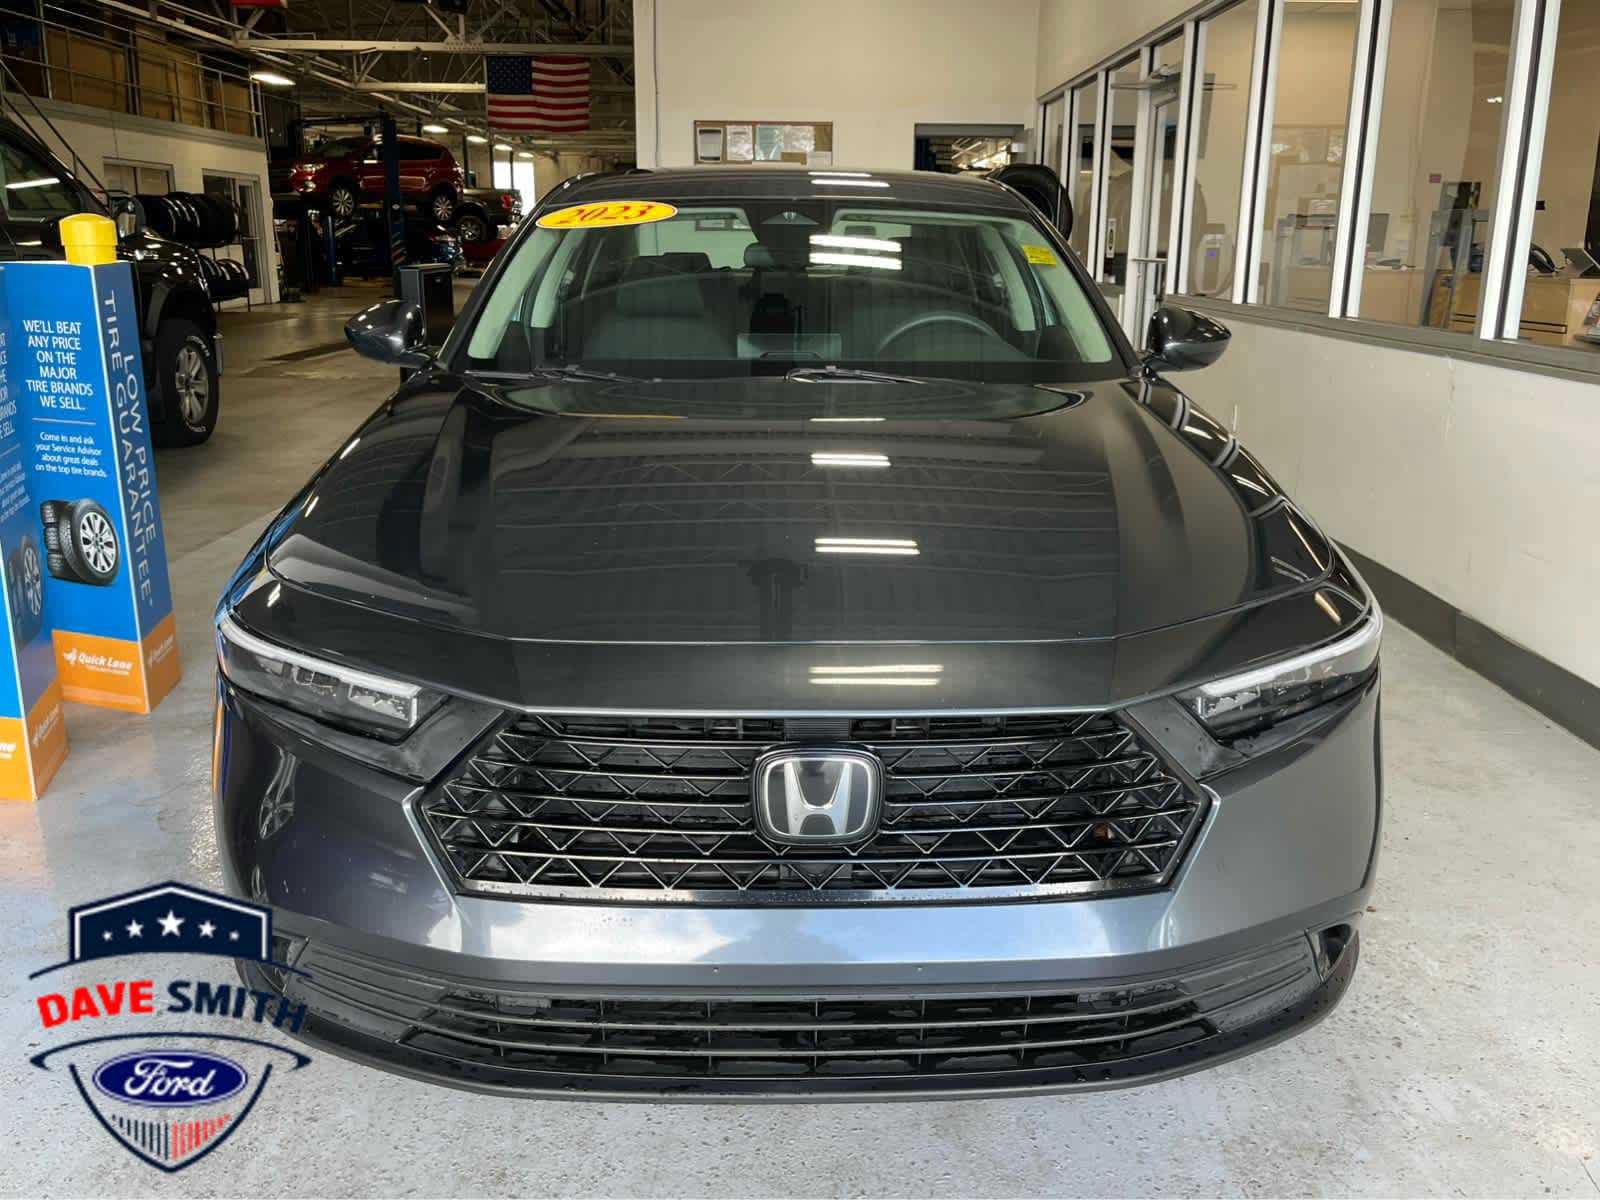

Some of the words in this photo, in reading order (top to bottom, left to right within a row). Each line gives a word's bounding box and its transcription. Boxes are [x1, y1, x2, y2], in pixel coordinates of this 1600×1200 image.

[554, 205, 656, 224] 2023
[23, 319, 54, 334] WE'LL
[56, 321, 81, 335] BEAT
[104, 289, 123, 372] TIRE
[28, 336, 49, 349] ANY
[52, 337, 81, 351] PRICE
[36, 351, 53, 364] ON
[55, 352, 77, 366] THE
[39, 366, 77, 380] MAJOR
[25, 379, 49, 393] TIRE
[50, 381, 94, 396] BRANDS
[40, 395, 58, 408] WE
[40, 431, 60, 441] Come
[51, 443, 76, 454] Service
[123, 354, 143, 433] LOW
[135, 446, 157, 544] PRICE
[79, 651, 107, 667] Quick
[107, 656, 134, 671] Lane
